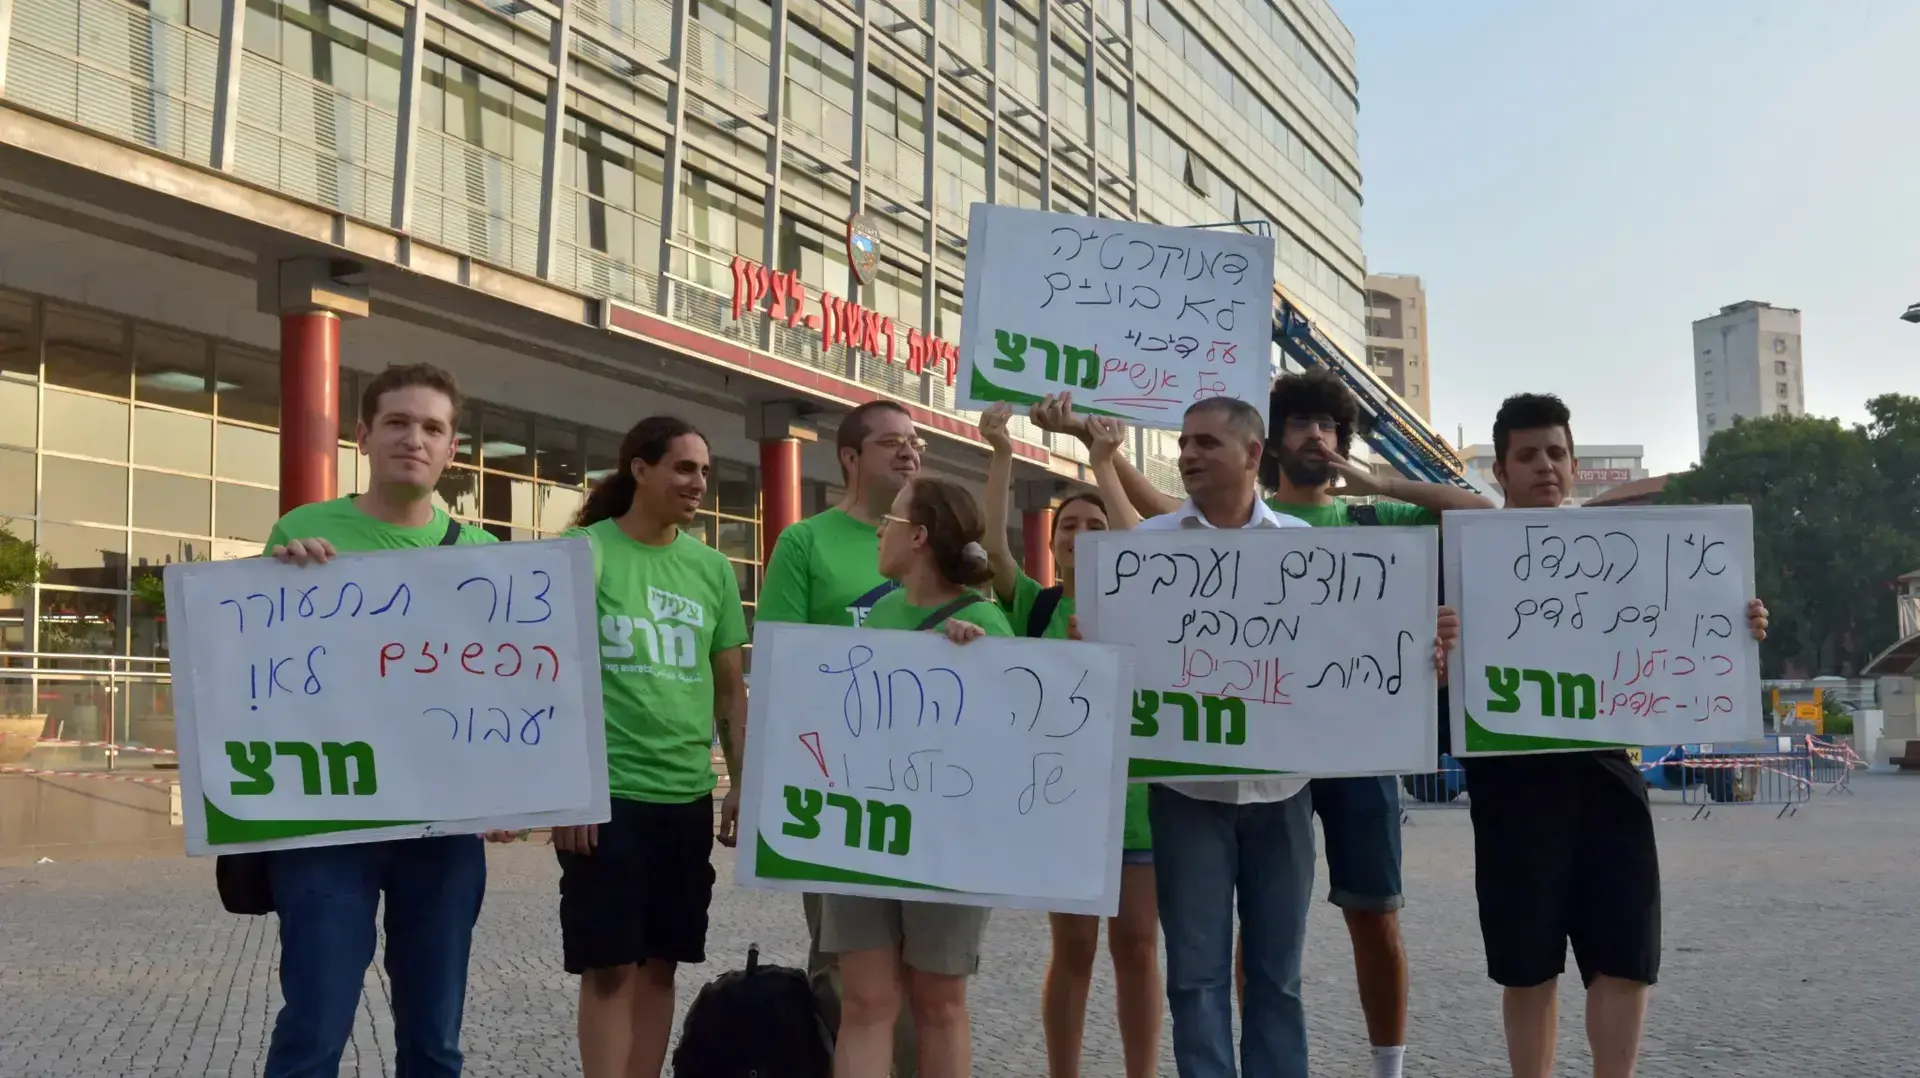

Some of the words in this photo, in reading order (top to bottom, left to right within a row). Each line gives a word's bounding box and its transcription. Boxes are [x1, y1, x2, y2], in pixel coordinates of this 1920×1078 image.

[1051, 227, 1249, 285] דמוקרטיה
[1040, 272, 1162, 309] בונים
[1177, 295, 1246, 331] לא
[906, 327, 960, 387] ריית
[993, 328, 1101, 390] מרצ
[1205, 340, 1238, 364] על
[1104, 548, 1241, 600] וערבים
[1263, 547, 1396, 605] יהודים
[1513, 525, 1639, 584] הבדל
[1664, 533, 1727, 611] אין
[456, 570, 553, 624] צור
[1507, 591, 1589, 640] לדם
[1603, 604, 1661, 638] דם
[600, 614, 697, 668] מרצ
[1692, 613, 1733, 648] בין
[379, 642, 560, 682] הפשיזם
[1306, 630, 1414, 695] להיות
[1003, 666, 1091, 738] זה
[1130, 689, 1246, 746] מרצ
[1485, 665, 1597, 720] מרצ
[422, 705, 556, 746] יעבור
[224, 740, 378, 796] מרצ
[1018, 752, 1077, 815] של
[781, 784, 912, 856] מרצ
